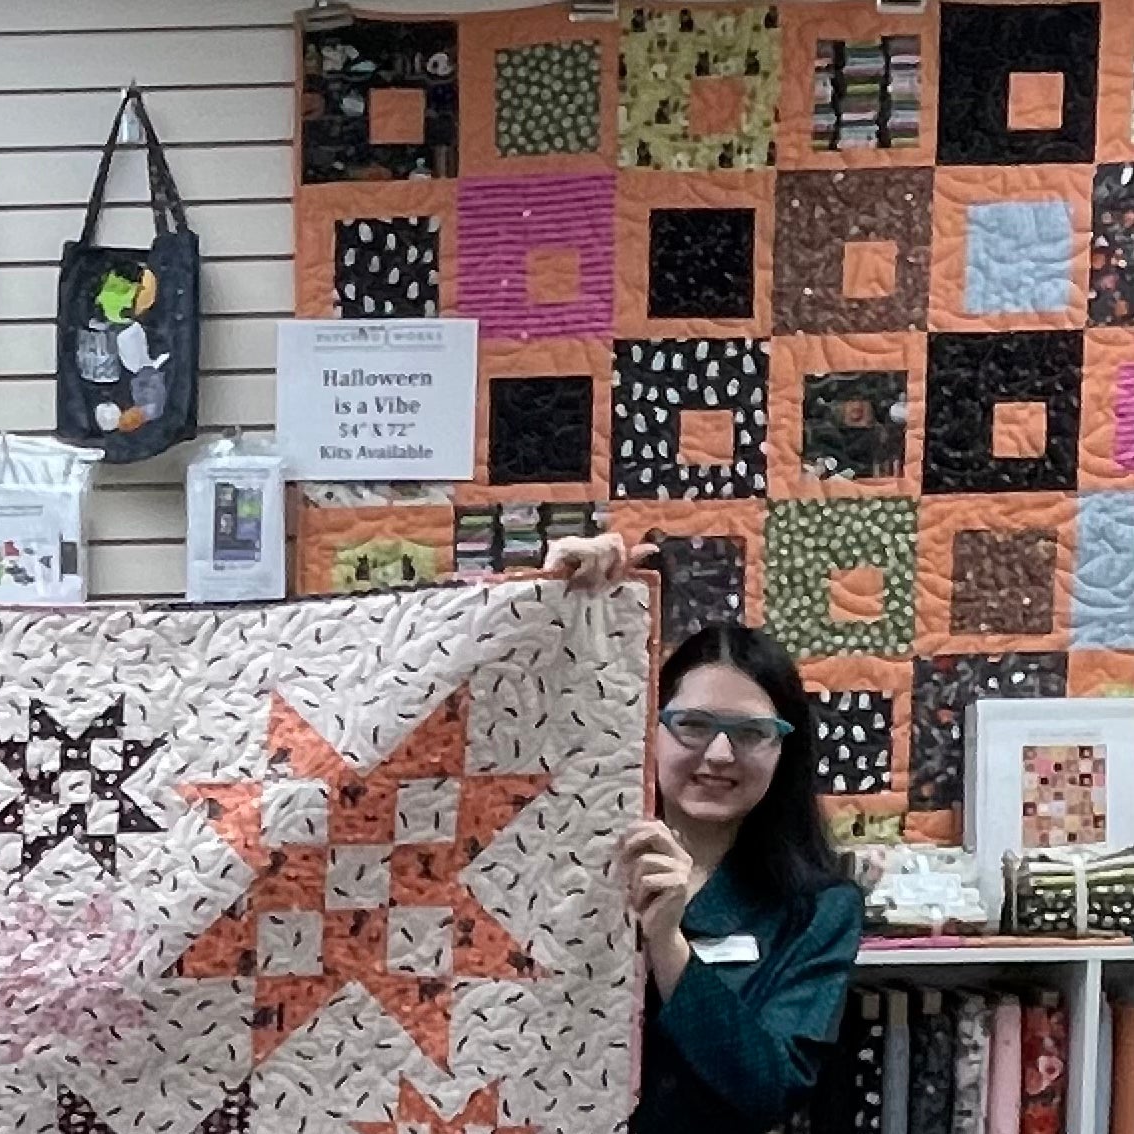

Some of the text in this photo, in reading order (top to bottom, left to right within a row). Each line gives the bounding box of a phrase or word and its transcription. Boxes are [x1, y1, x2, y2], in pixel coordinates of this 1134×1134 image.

[322, 368, 433, 386] Halloween
[334, 396, 421, 414] is a Vibe
[320, 444, 433, 459] Kits Available
